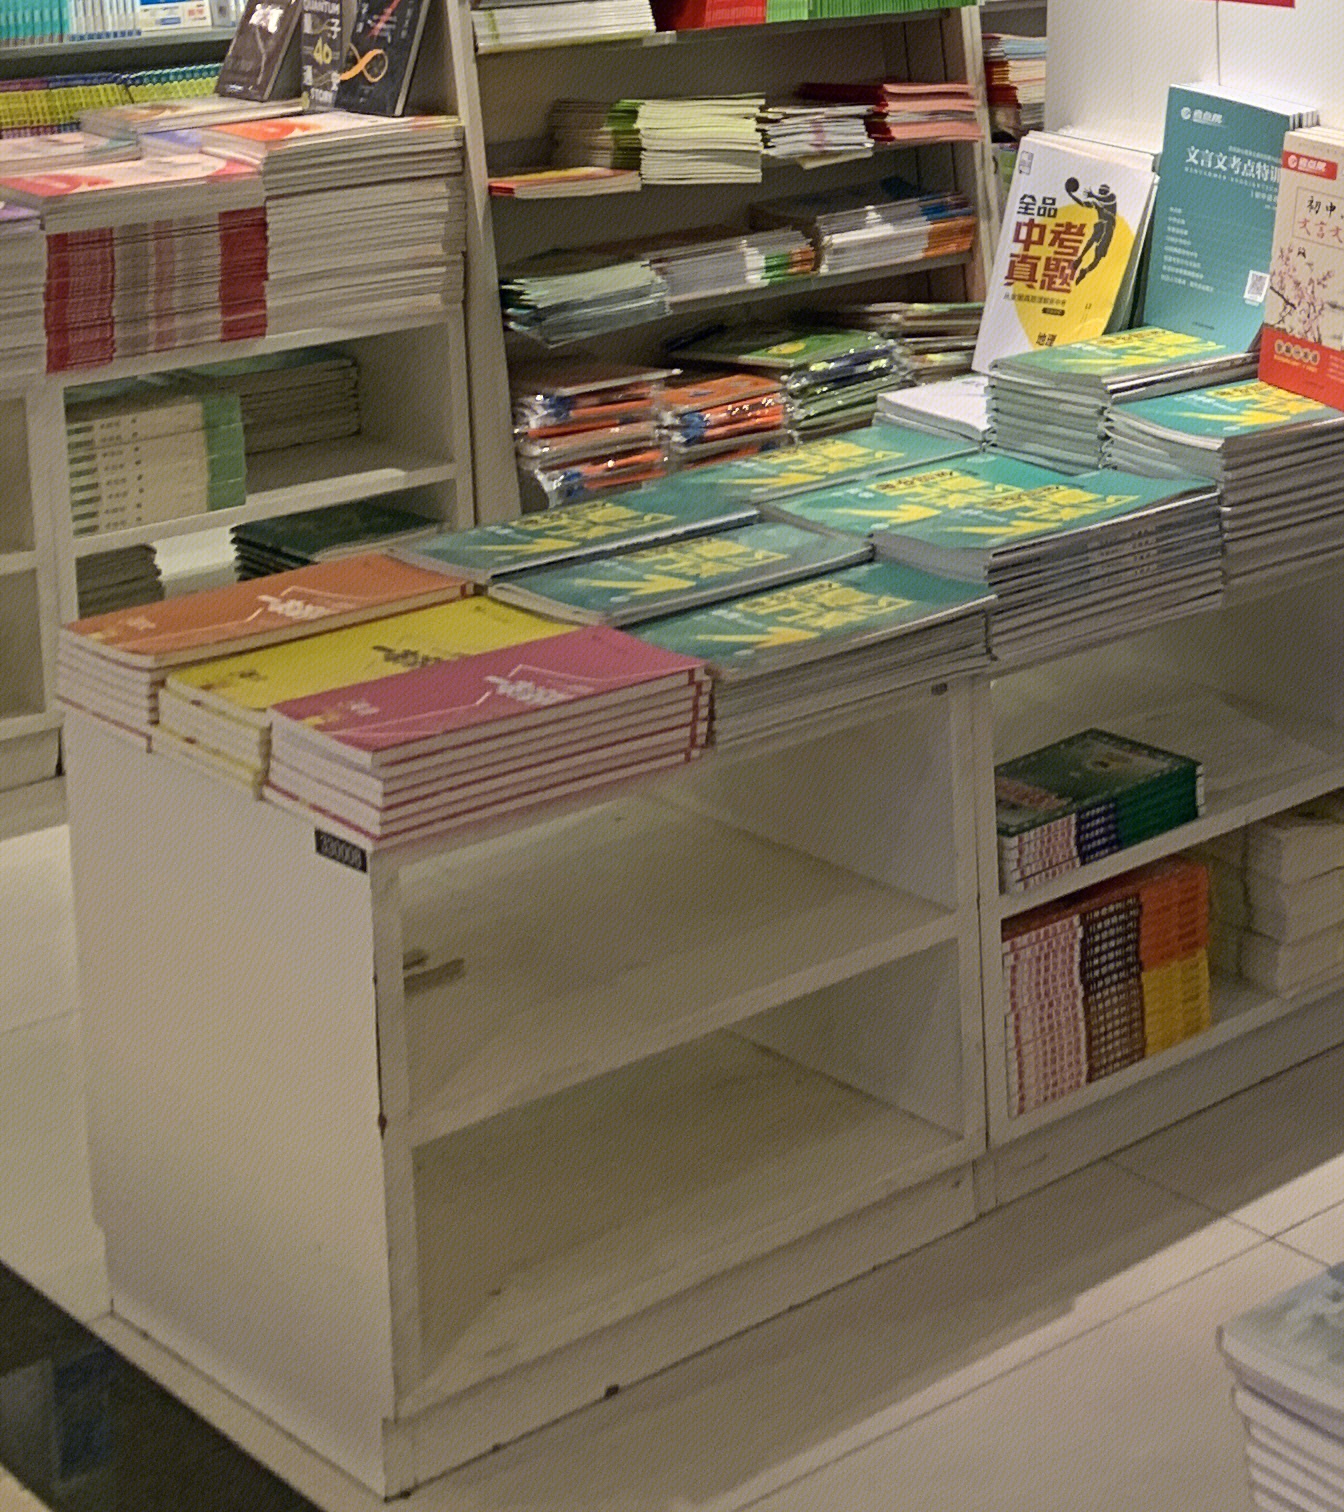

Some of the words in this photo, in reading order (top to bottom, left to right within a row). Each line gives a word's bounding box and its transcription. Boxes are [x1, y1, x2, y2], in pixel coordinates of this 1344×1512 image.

[1017, 193, 1058, 218] 全品
[1013, 218, 1087, 257] 中考
[1004, 253, 1077, 294] 真题
